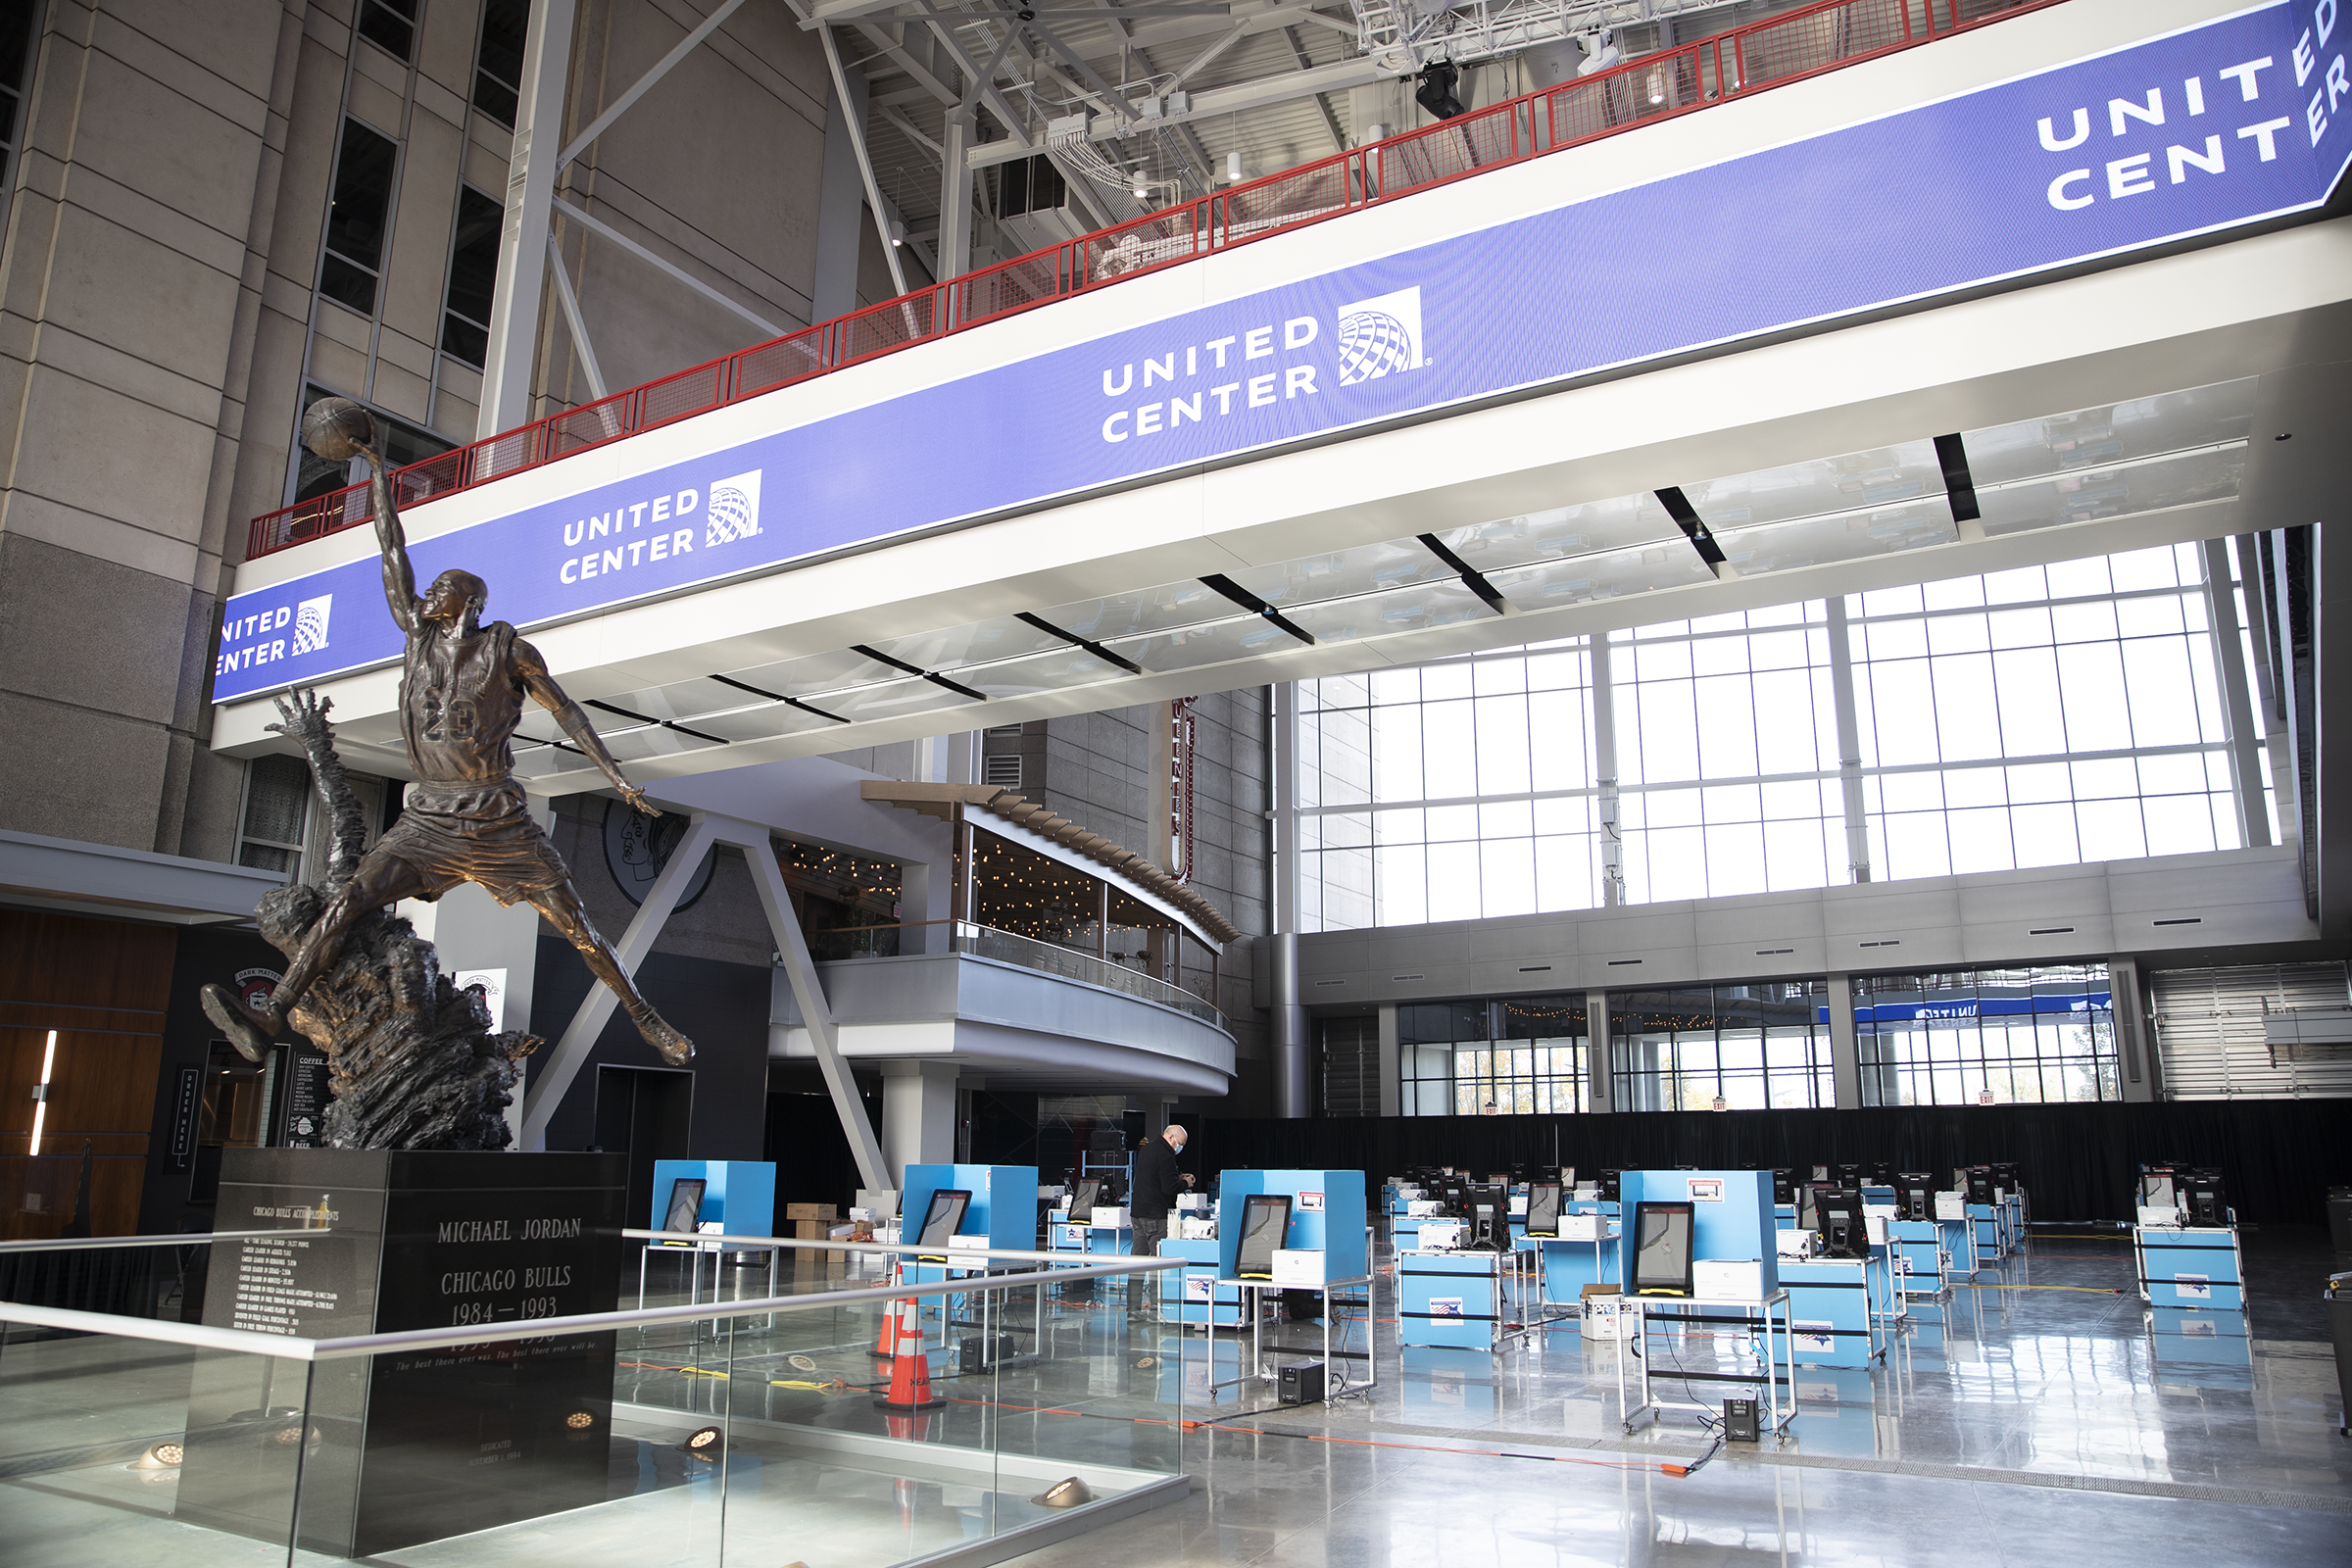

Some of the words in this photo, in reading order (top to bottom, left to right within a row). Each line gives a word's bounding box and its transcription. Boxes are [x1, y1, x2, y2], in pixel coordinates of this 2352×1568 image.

[2046, 54, 2351, 211] CENTER
[1102, 316, 1318, 397] UNITED
[1101, 364, 1319, 443] CENTER
[564, 487, 699, 547] UNITED
[560, 528, 695, 586] CENTER
[221, 606, 291, 643] NITED
[216, 639, 286, 676] ENTER
[420, 699, 477, 743] 23
[259, 969, 282, 982] MATTER
[182, 1074, 192, 1113] ORDER
[253, 1206, 274, 1217] CHICAGO
[276, 1207, 291, 1218] BULLS
[437, 1220, 512, 1243] MICHAEL
[521, 1218, 581, 1240] JORDAN
[441, 1269, 515, 1295] CHICAGO
[524, 1266, 570, 1289] BULLS
[452, 1302, 493, 1325] 1984
[520, 1297, 557, 1319] 1993
[396, 1362, 410, 1371] The
[415, 1360, 431, 1369] best
[435, 1357, 455, 1366] there
[497, 1350, 510, 1359] The
[513, 1348, 527, 1357] best
[531, 1346, 550, 1355] there
[480, 1439, 512, 1451] DEDICATED
